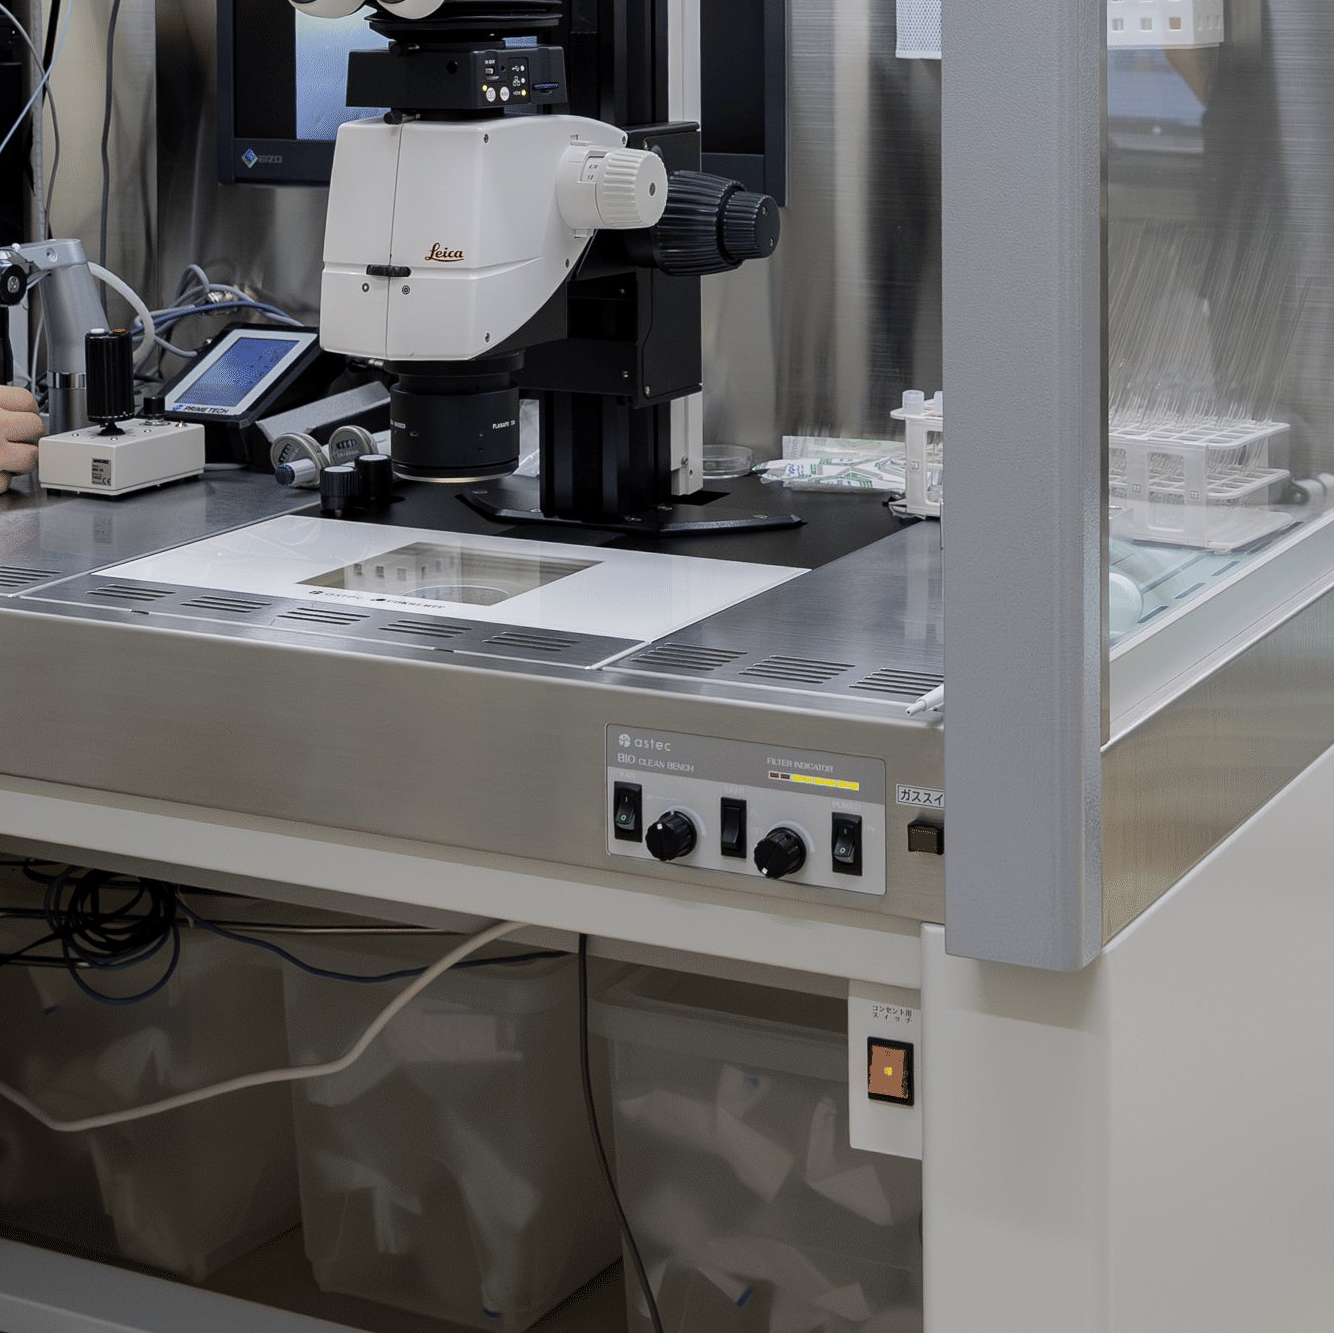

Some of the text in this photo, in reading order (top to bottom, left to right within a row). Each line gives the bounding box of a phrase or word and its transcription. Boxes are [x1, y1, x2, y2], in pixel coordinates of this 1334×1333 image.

[424, 243, 464, 262] Leica
[634, 738, 671, 752] astec
[617, 753, 694, 772] BIO CLEAN BENCH
[767, 757, 834, 773] FILTER INDICATOR
[901, 789, 944, 806] ガススイ
[872, 1005, 912, 1017] コンセント用
